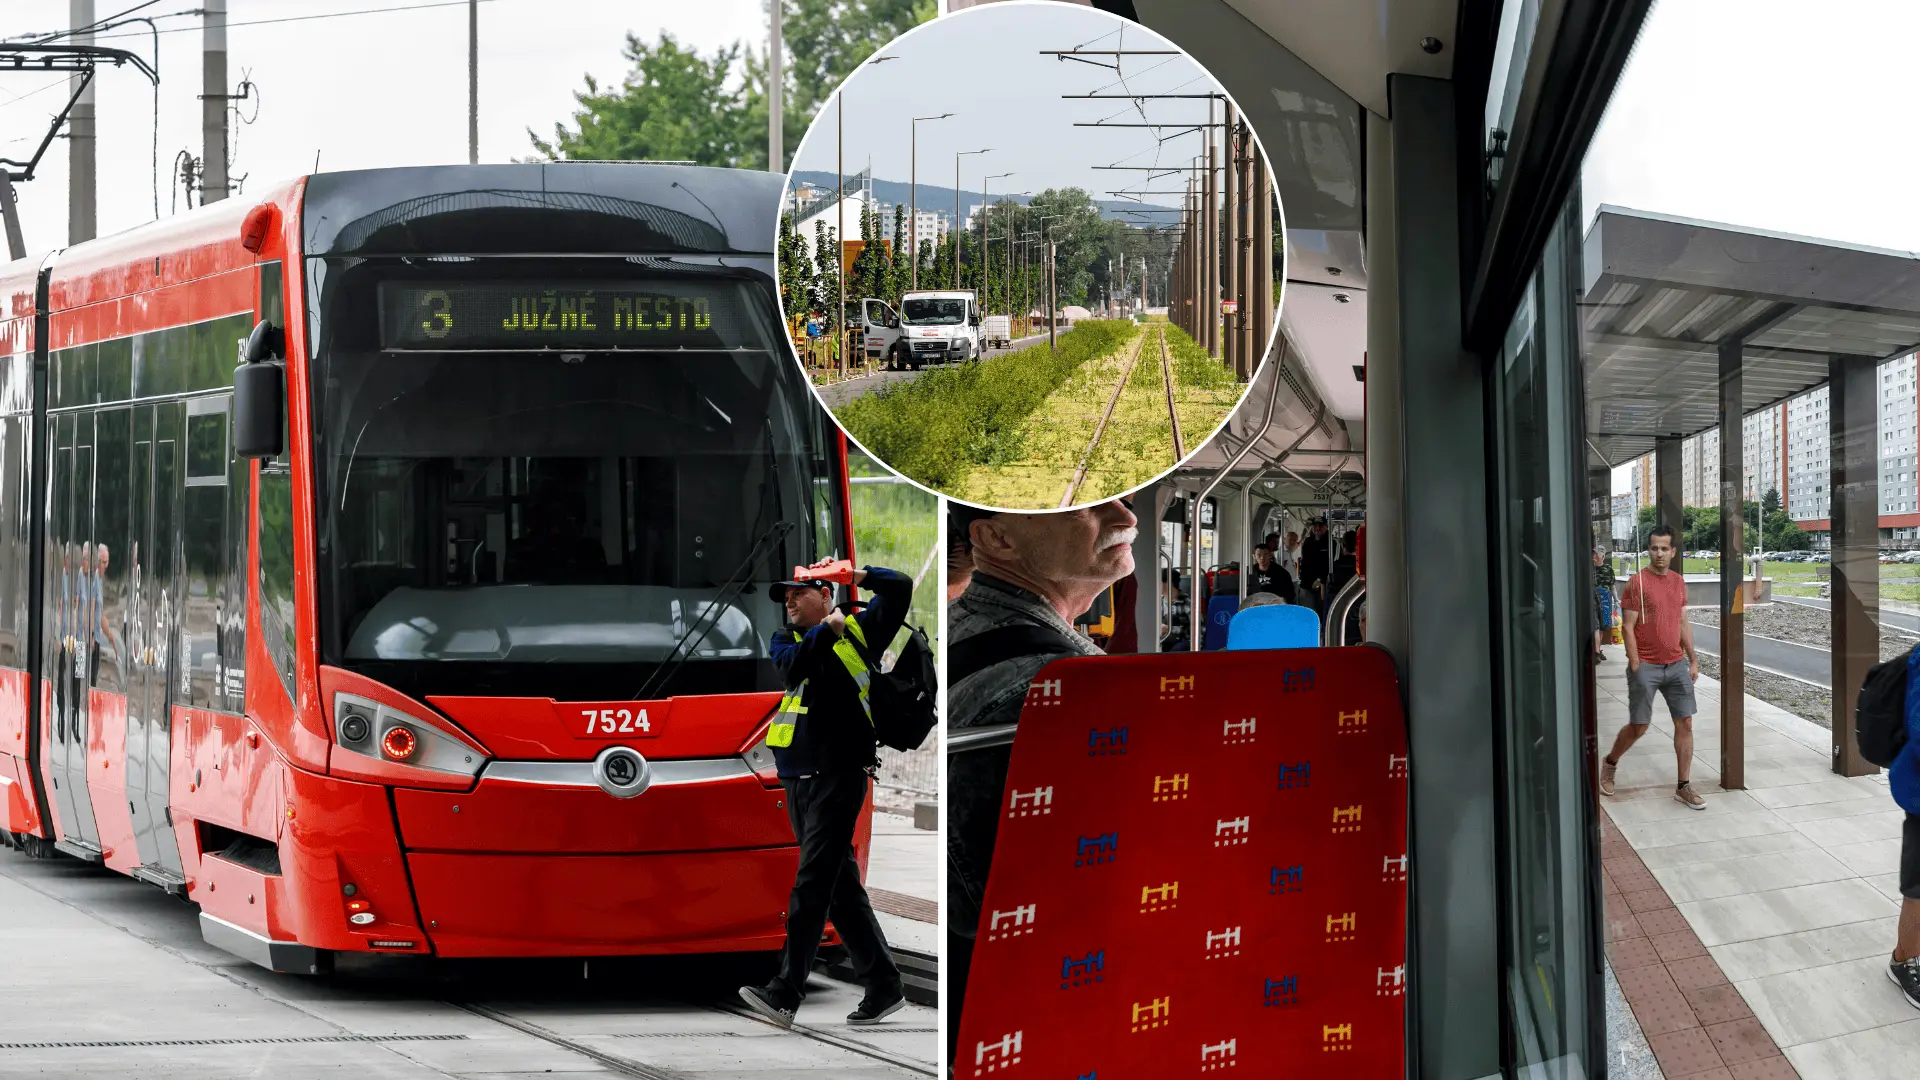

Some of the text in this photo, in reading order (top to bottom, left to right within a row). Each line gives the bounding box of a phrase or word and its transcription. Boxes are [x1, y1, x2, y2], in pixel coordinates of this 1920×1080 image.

[422, 290, 711, 338] 3 JUŽNÉ MESTO
[581, 708, 651, 734] 7524
